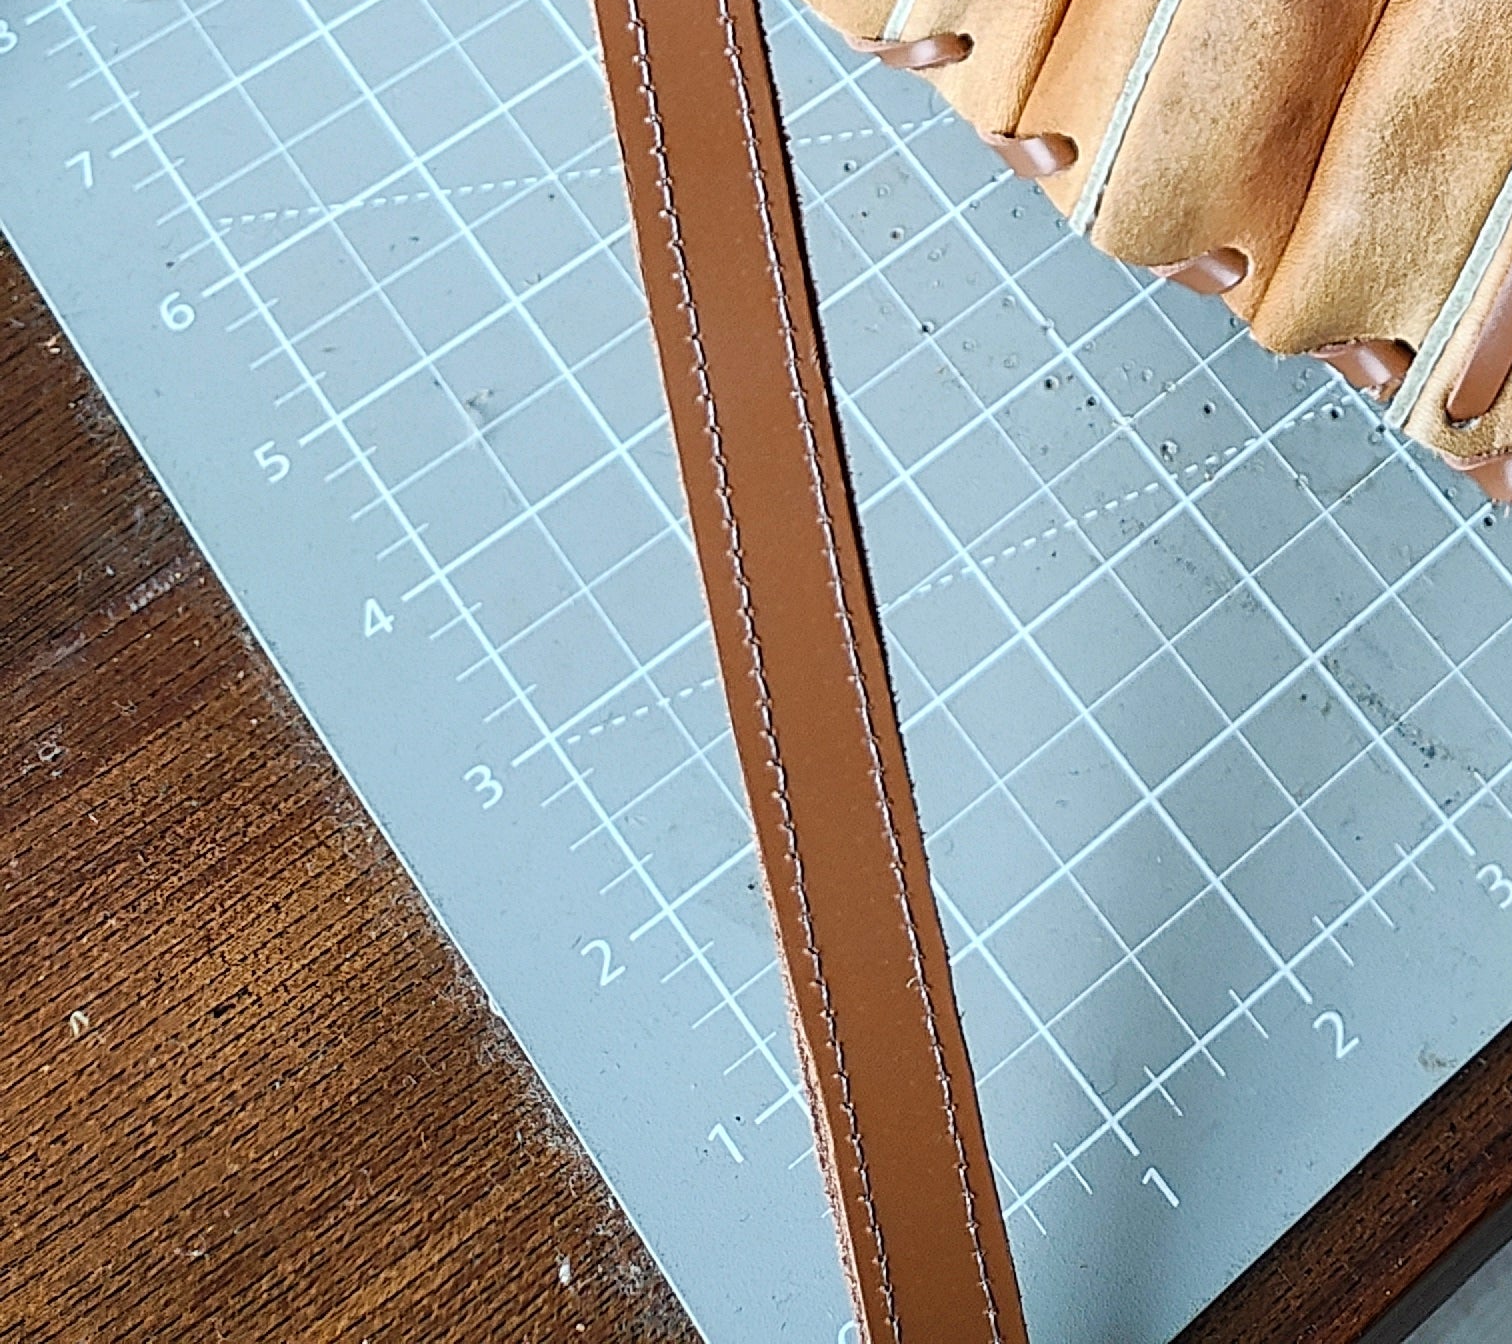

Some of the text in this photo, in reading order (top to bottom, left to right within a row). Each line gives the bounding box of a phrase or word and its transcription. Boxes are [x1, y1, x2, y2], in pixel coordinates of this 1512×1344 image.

[64, 150, 94, 190] 7
[158, 290, 197, 332] 6
[252, 439, 292, 484] 5
[362, 597, 396, 638] 4
[463, 763, 505, 811] 3
[580, 939, 627, 988] 2
[1311, 1010, 1361, 1060] 2
[707, 1121, 746, 1165] 1
[1141, 1166, 1181, 1209] 1
